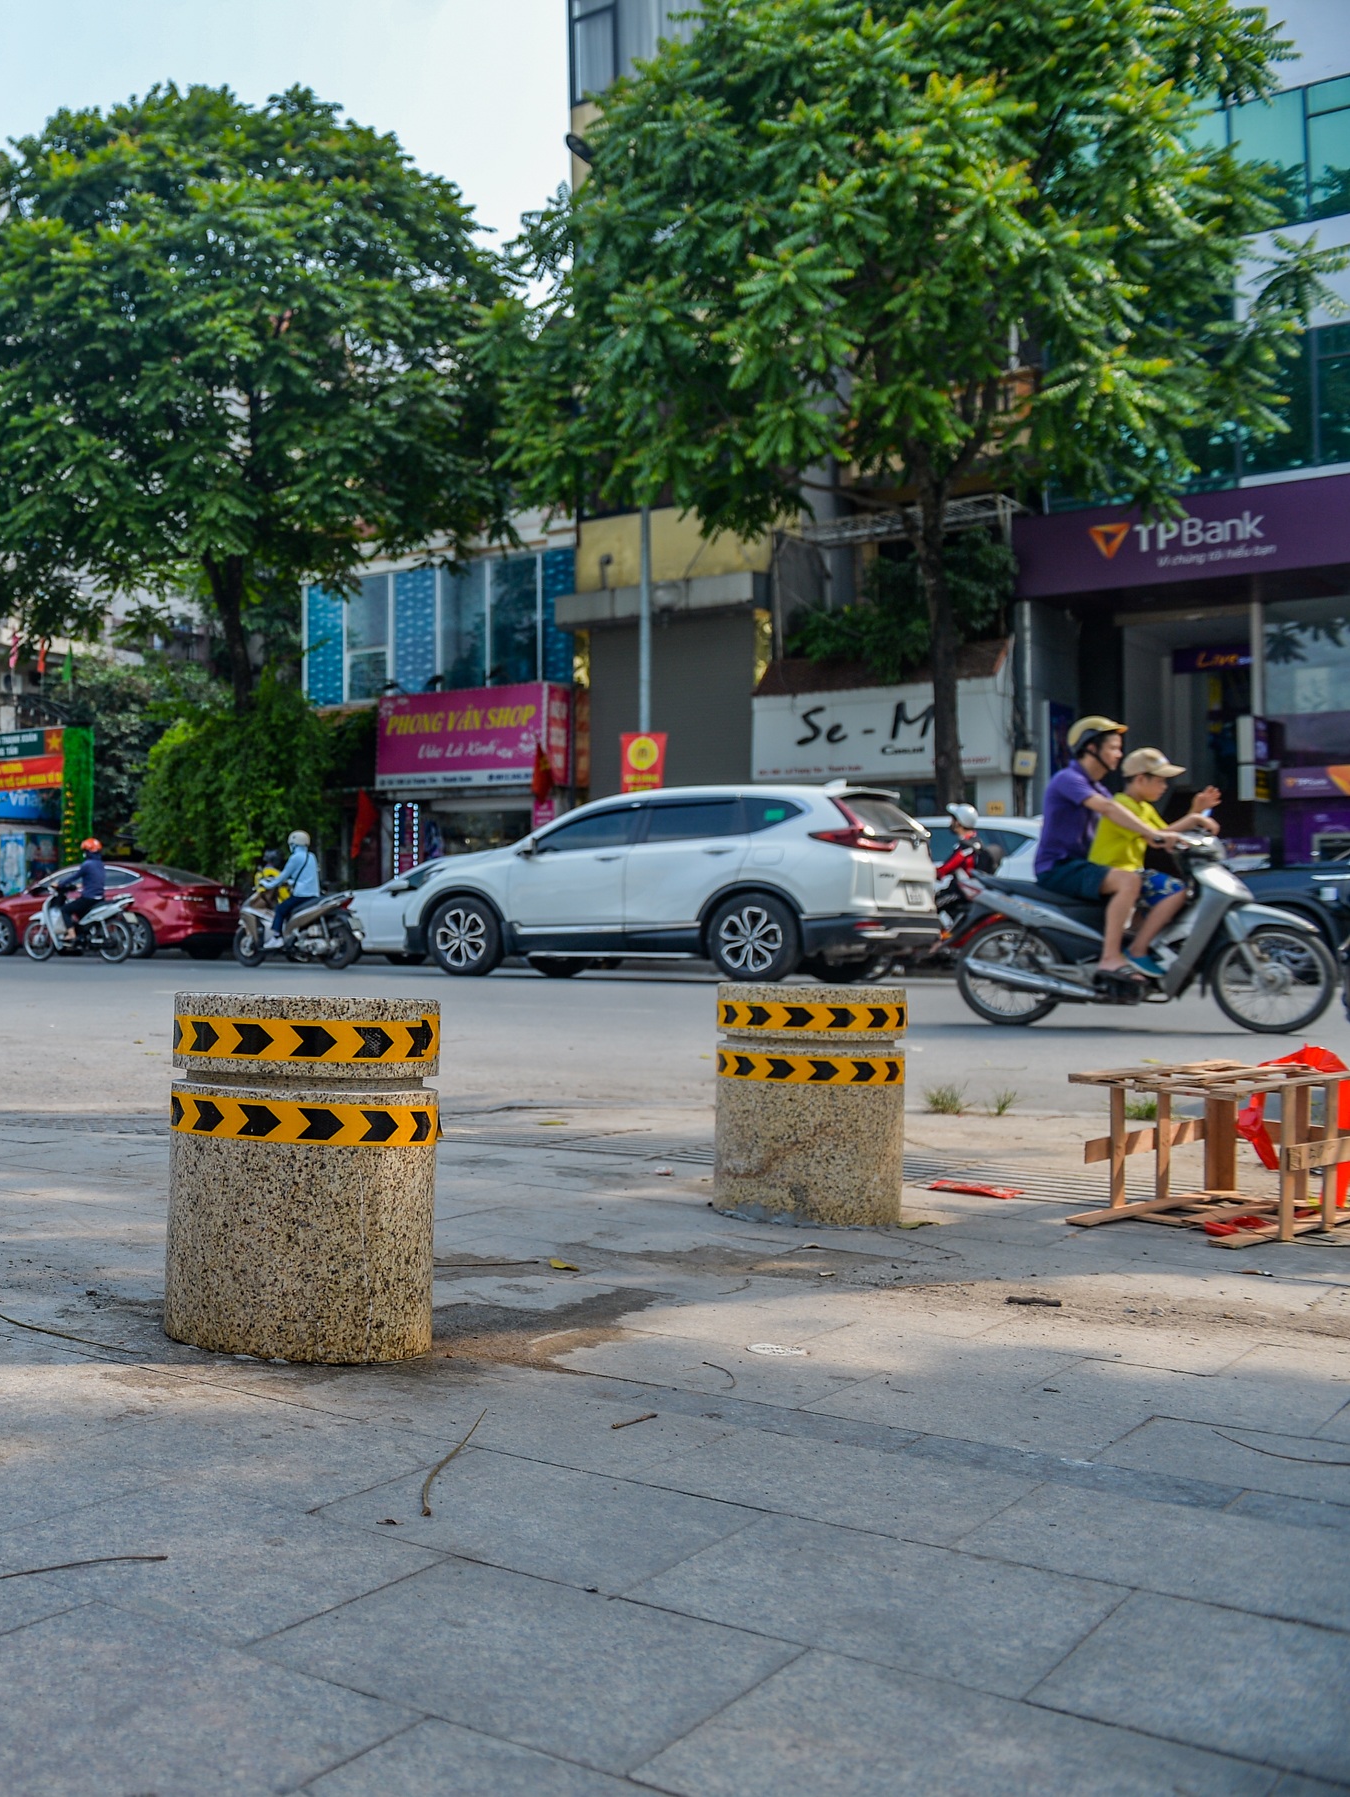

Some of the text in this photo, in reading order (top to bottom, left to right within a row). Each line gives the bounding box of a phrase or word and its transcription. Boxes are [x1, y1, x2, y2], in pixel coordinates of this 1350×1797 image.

[1133, 511, 1265, 552] TPBank
[1171, 552, 1205, 566] chúng
[1208, 548, 1224, 562] tôi
[385, 711, 445, 737] PHONG
[484, 704, 537, 730] SHOP
[891, 702, 935, 740] M
